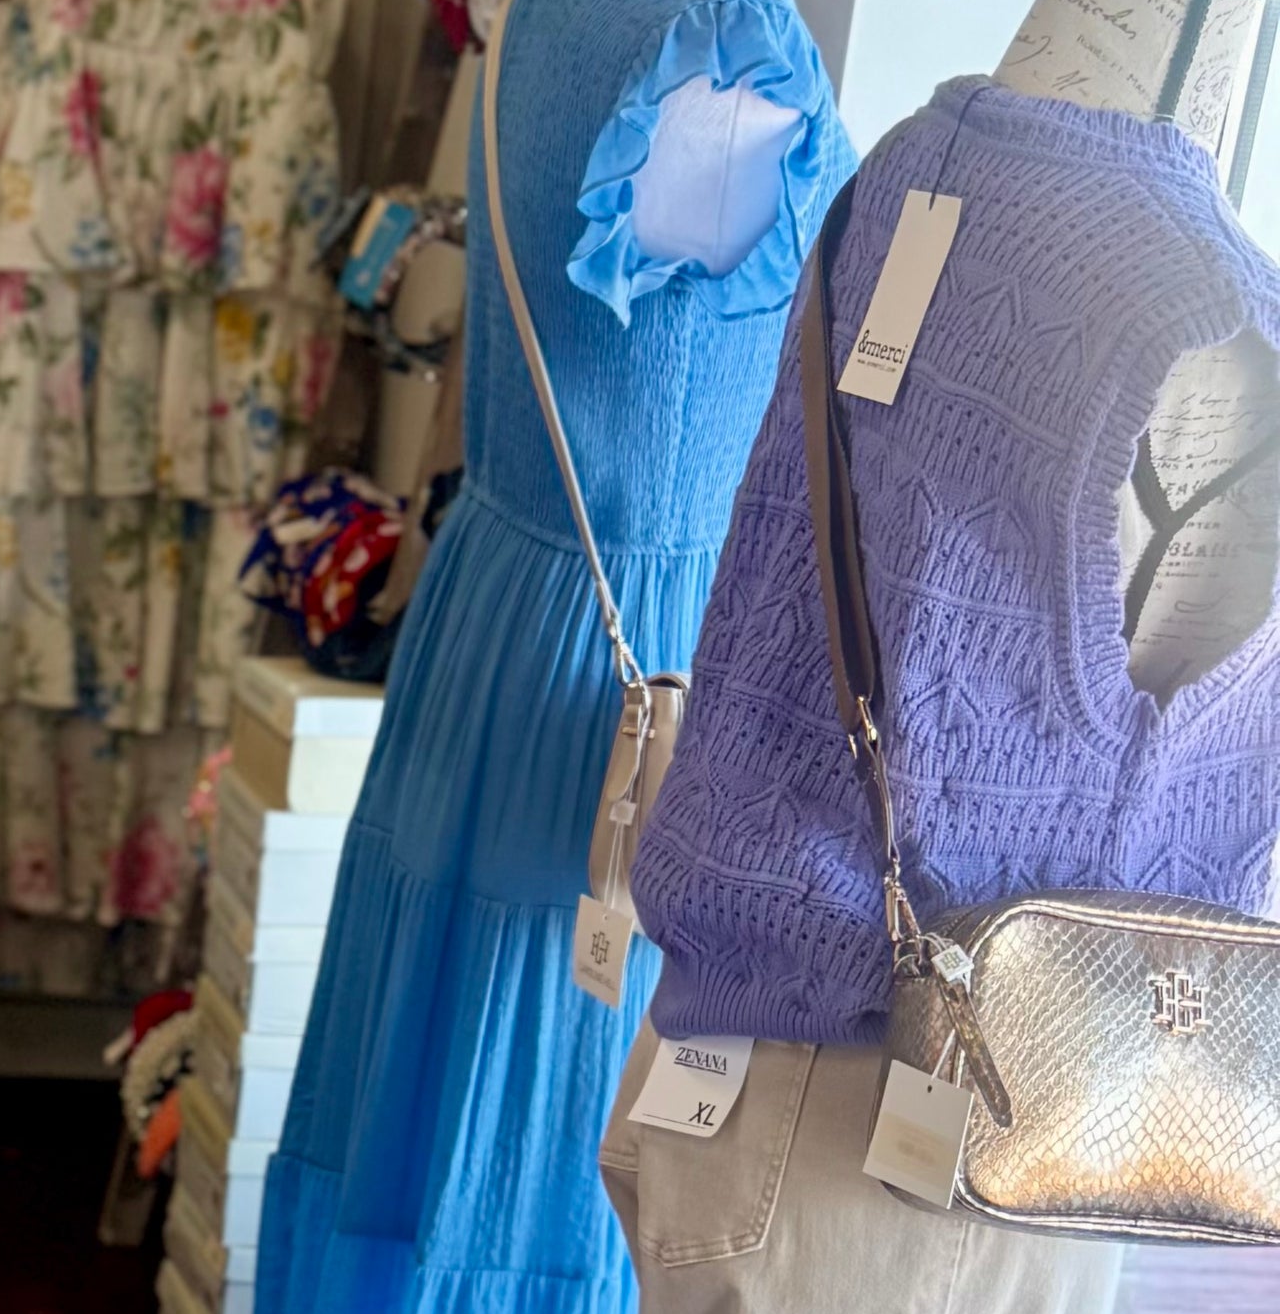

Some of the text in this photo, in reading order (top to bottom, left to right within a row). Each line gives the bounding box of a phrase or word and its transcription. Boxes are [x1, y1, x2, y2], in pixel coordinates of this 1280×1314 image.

[857, 328, 908, 364] &merci
[674, 1046, 727, 1072] ZENANA
[688, 1101, 717, 1127] XL
